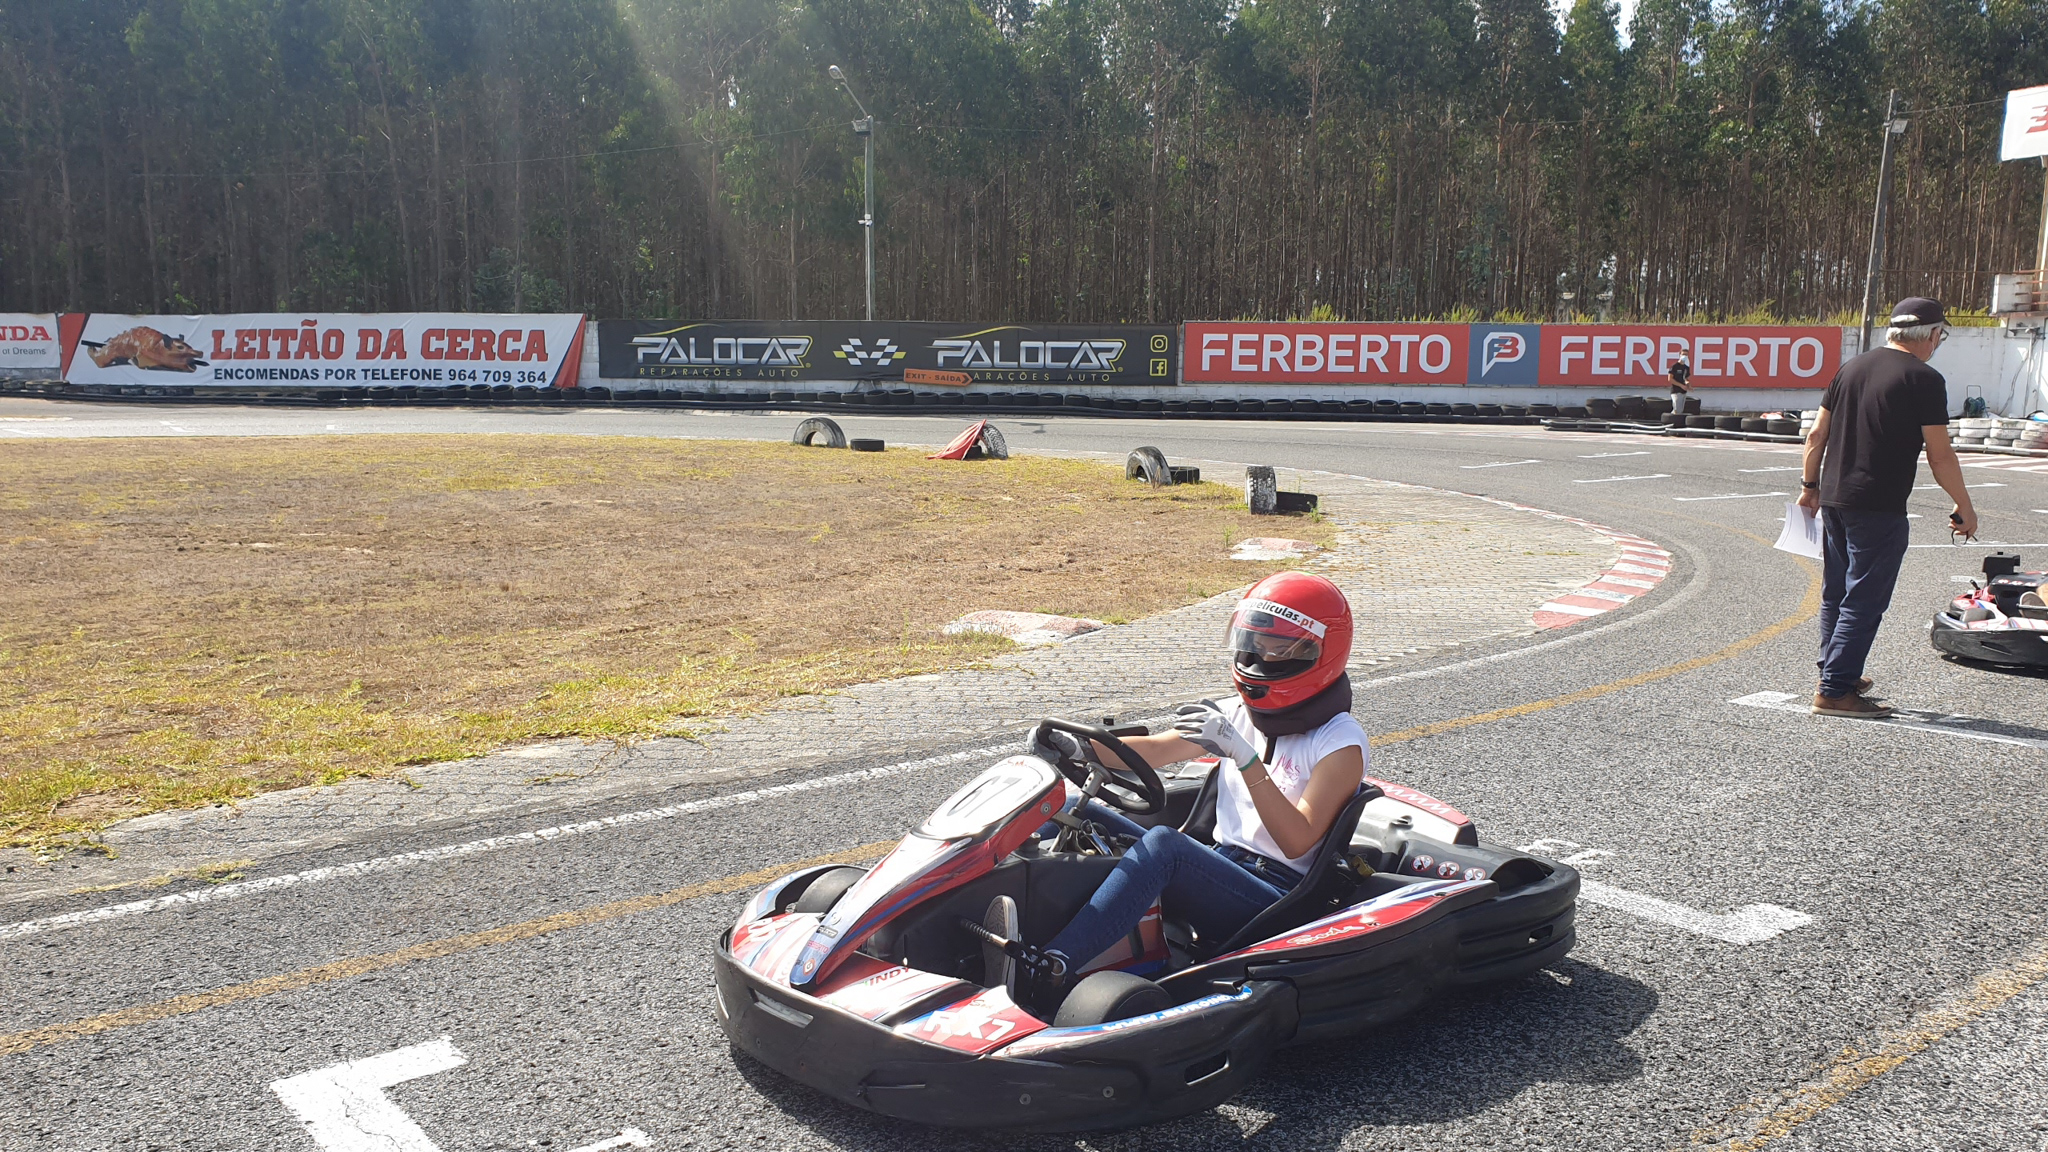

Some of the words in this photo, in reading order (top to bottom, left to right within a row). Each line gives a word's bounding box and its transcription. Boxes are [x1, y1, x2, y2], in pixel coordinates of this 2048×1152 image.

[12, 346, 47, 355] Dreams
[210, 318, 345, 360] LEITÃO
[356, 328, 407, 360] DA
[420, 328, 549, 362] CERCA
[631, 337, 809, 365] PALOCAR
[932, 340, 1123, 369] PALOCAR
[1201, 333, 1451, 374] FERBERTO
[1560, 335, 1824, 378] FERBERTO
[214, 368, 319, 380] ENCOMENDAS
[324, 368, 356, 380] POR
[361, 368, 443, 381] TELEFONE
[448, 368, 478, 381] 964
[483, 369, 512, 382] 709
[517, 370, 547, 383] 364
[640, 367, 743, 378] REPARAÇÕES
[758, 368, 799, 378] AUTO
[935, 374, 962, 382] SAÍDA
[974, 371, 1050, 382] ARAÇÕES
[1067, 373, 1110, 382] AUTO
